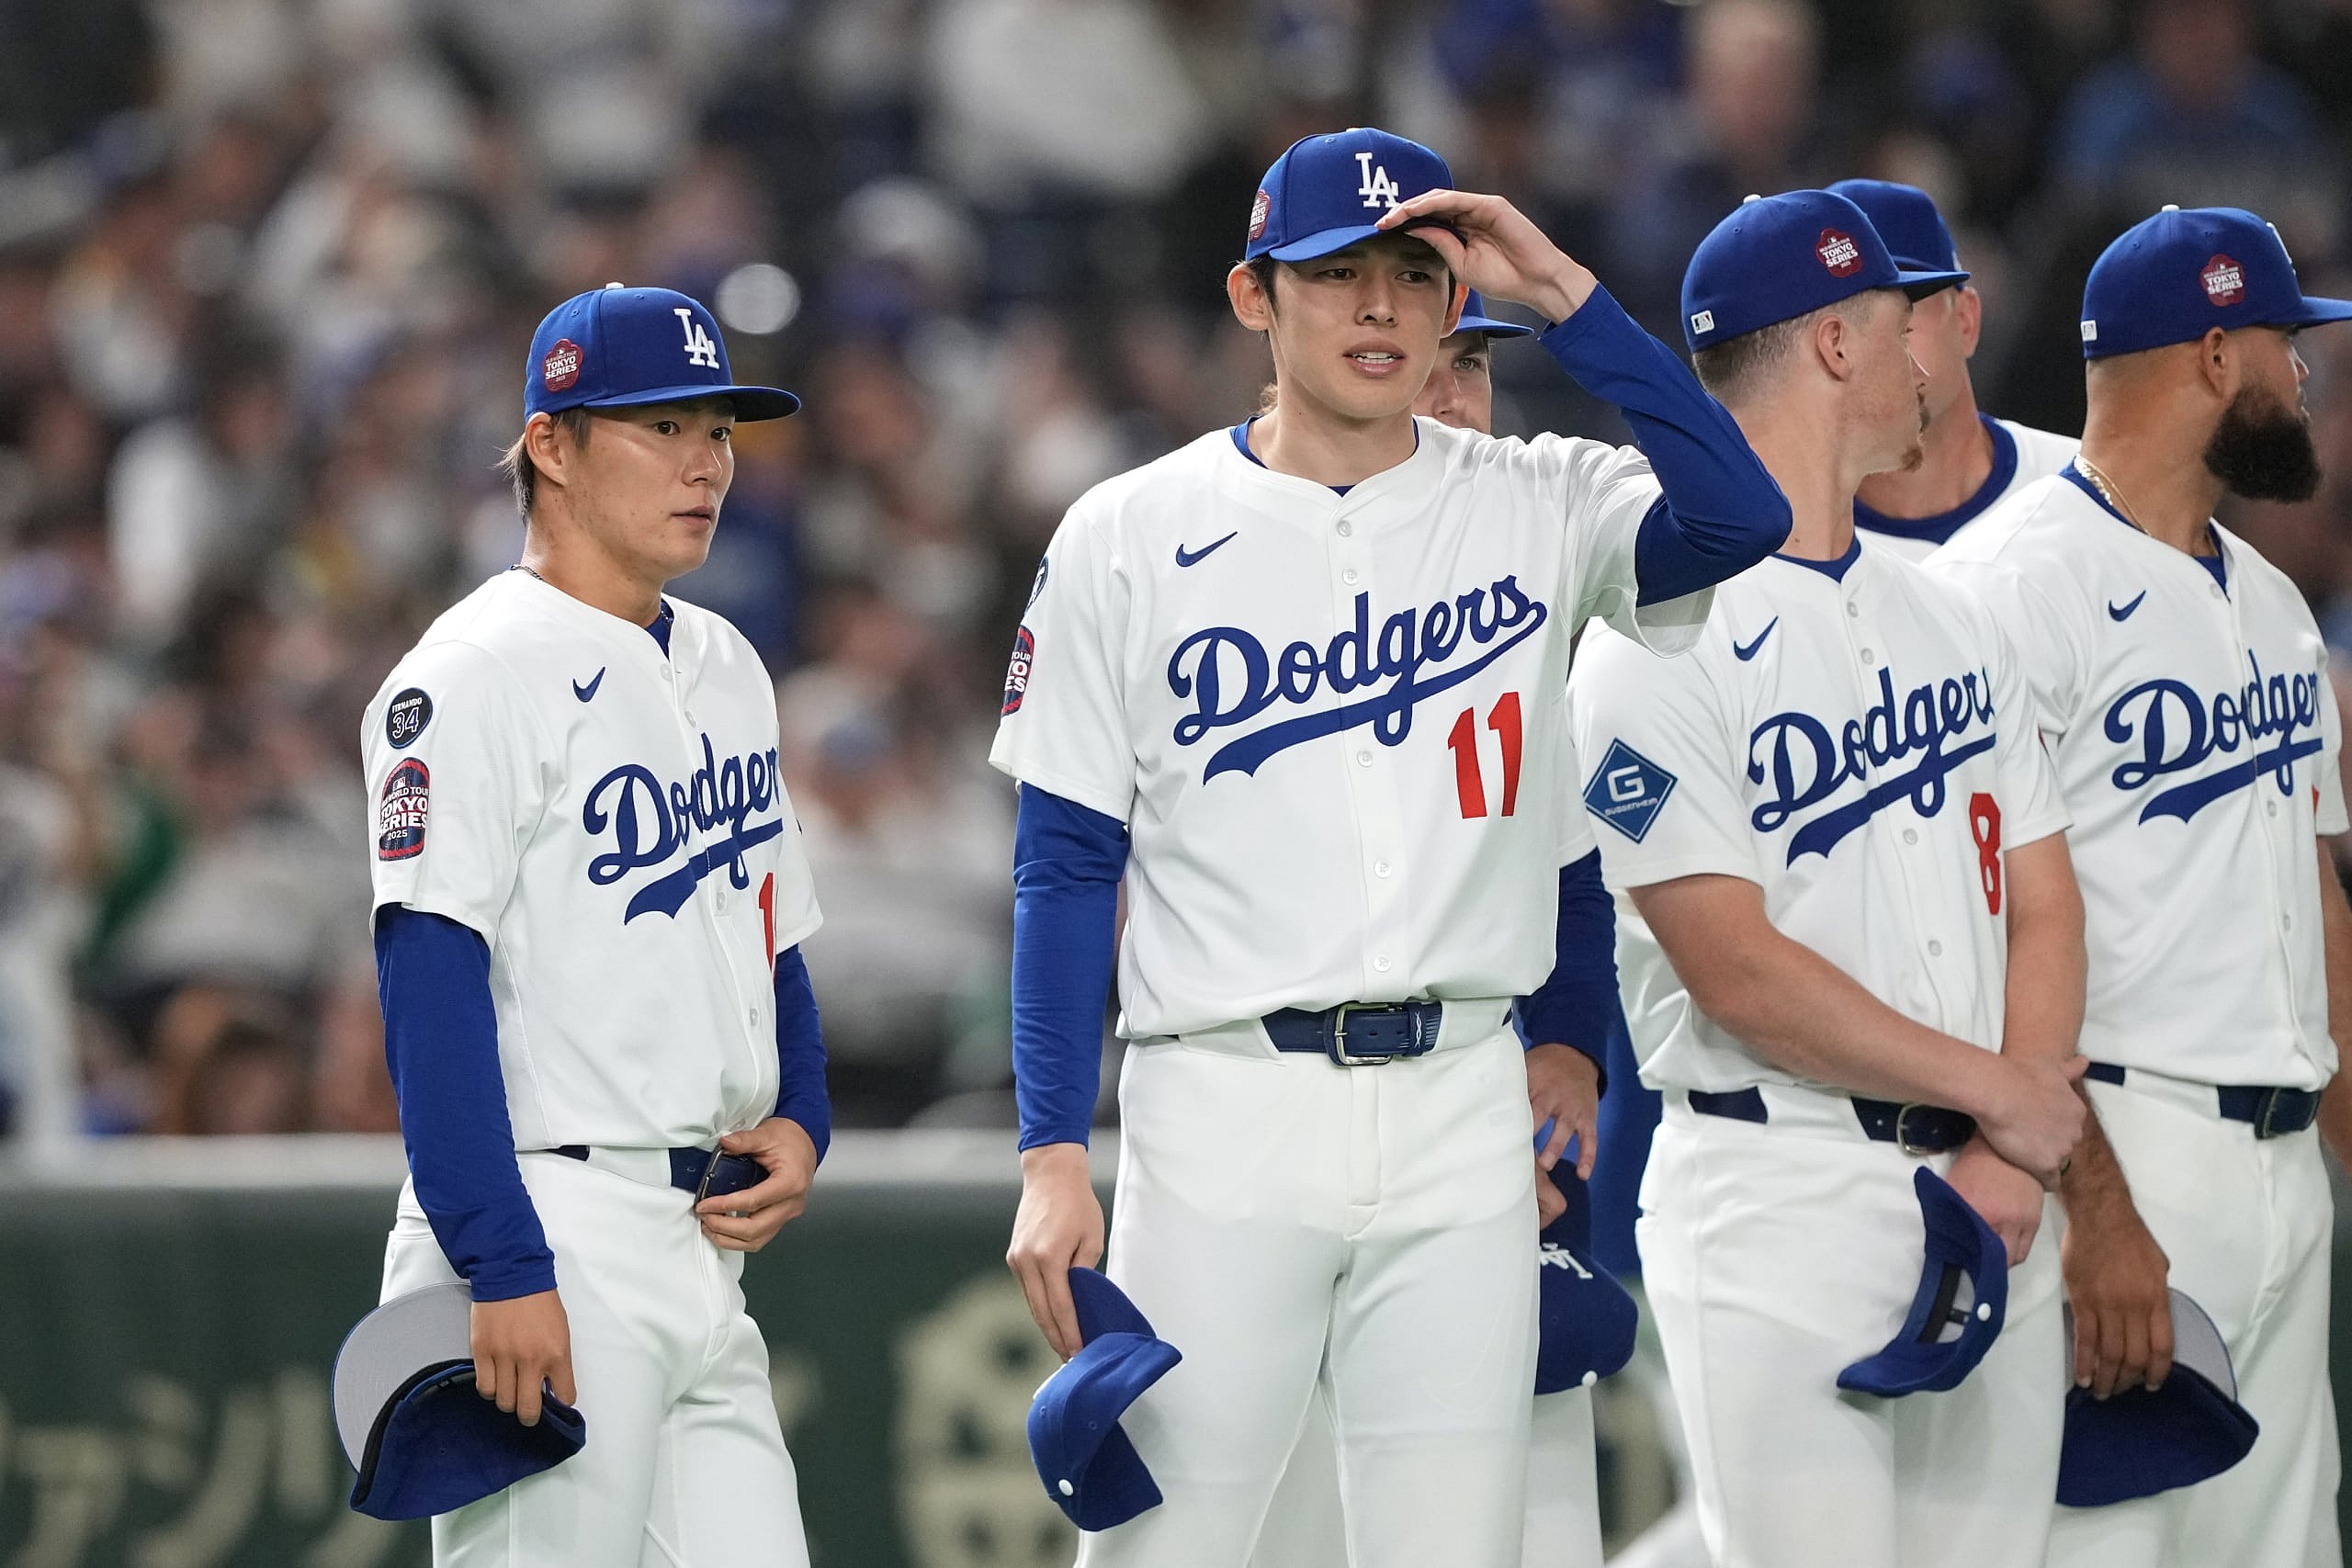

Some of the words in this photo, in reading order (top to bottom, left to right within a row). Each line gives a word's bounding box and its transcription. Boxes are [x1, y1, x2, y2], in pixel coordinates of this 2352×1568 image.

[1355, 152, 1400, 208] LA
[1823, 243, 1853, 259] TOKYO
[1826, 249, 1859, 267] SERIES
[2206, 272, 2240, 286] TOKYO
[2207, 279, 2243, 295] SERIES
[673, 309, 720, 370] LA
[545, 363, 577, 379] SERIES
[546, 355, 576, 371] TOKYO
[1168, 575, 1547, 747] Dodgers
[392, 697, 423, 713] FERNANDO
[392, 706, 420, 739] 34
[2104, 649, 2323, 796] Dodger
[1448, 692, 1523, 819] 11
[1747, 666, 1996, 833] Dodger
[583, 732, 780, 890] Dodger
[387, 829, 408, 840] 2025
[1969, 792, 2001, 916] 8
[759, 872, 775, 976] 1
